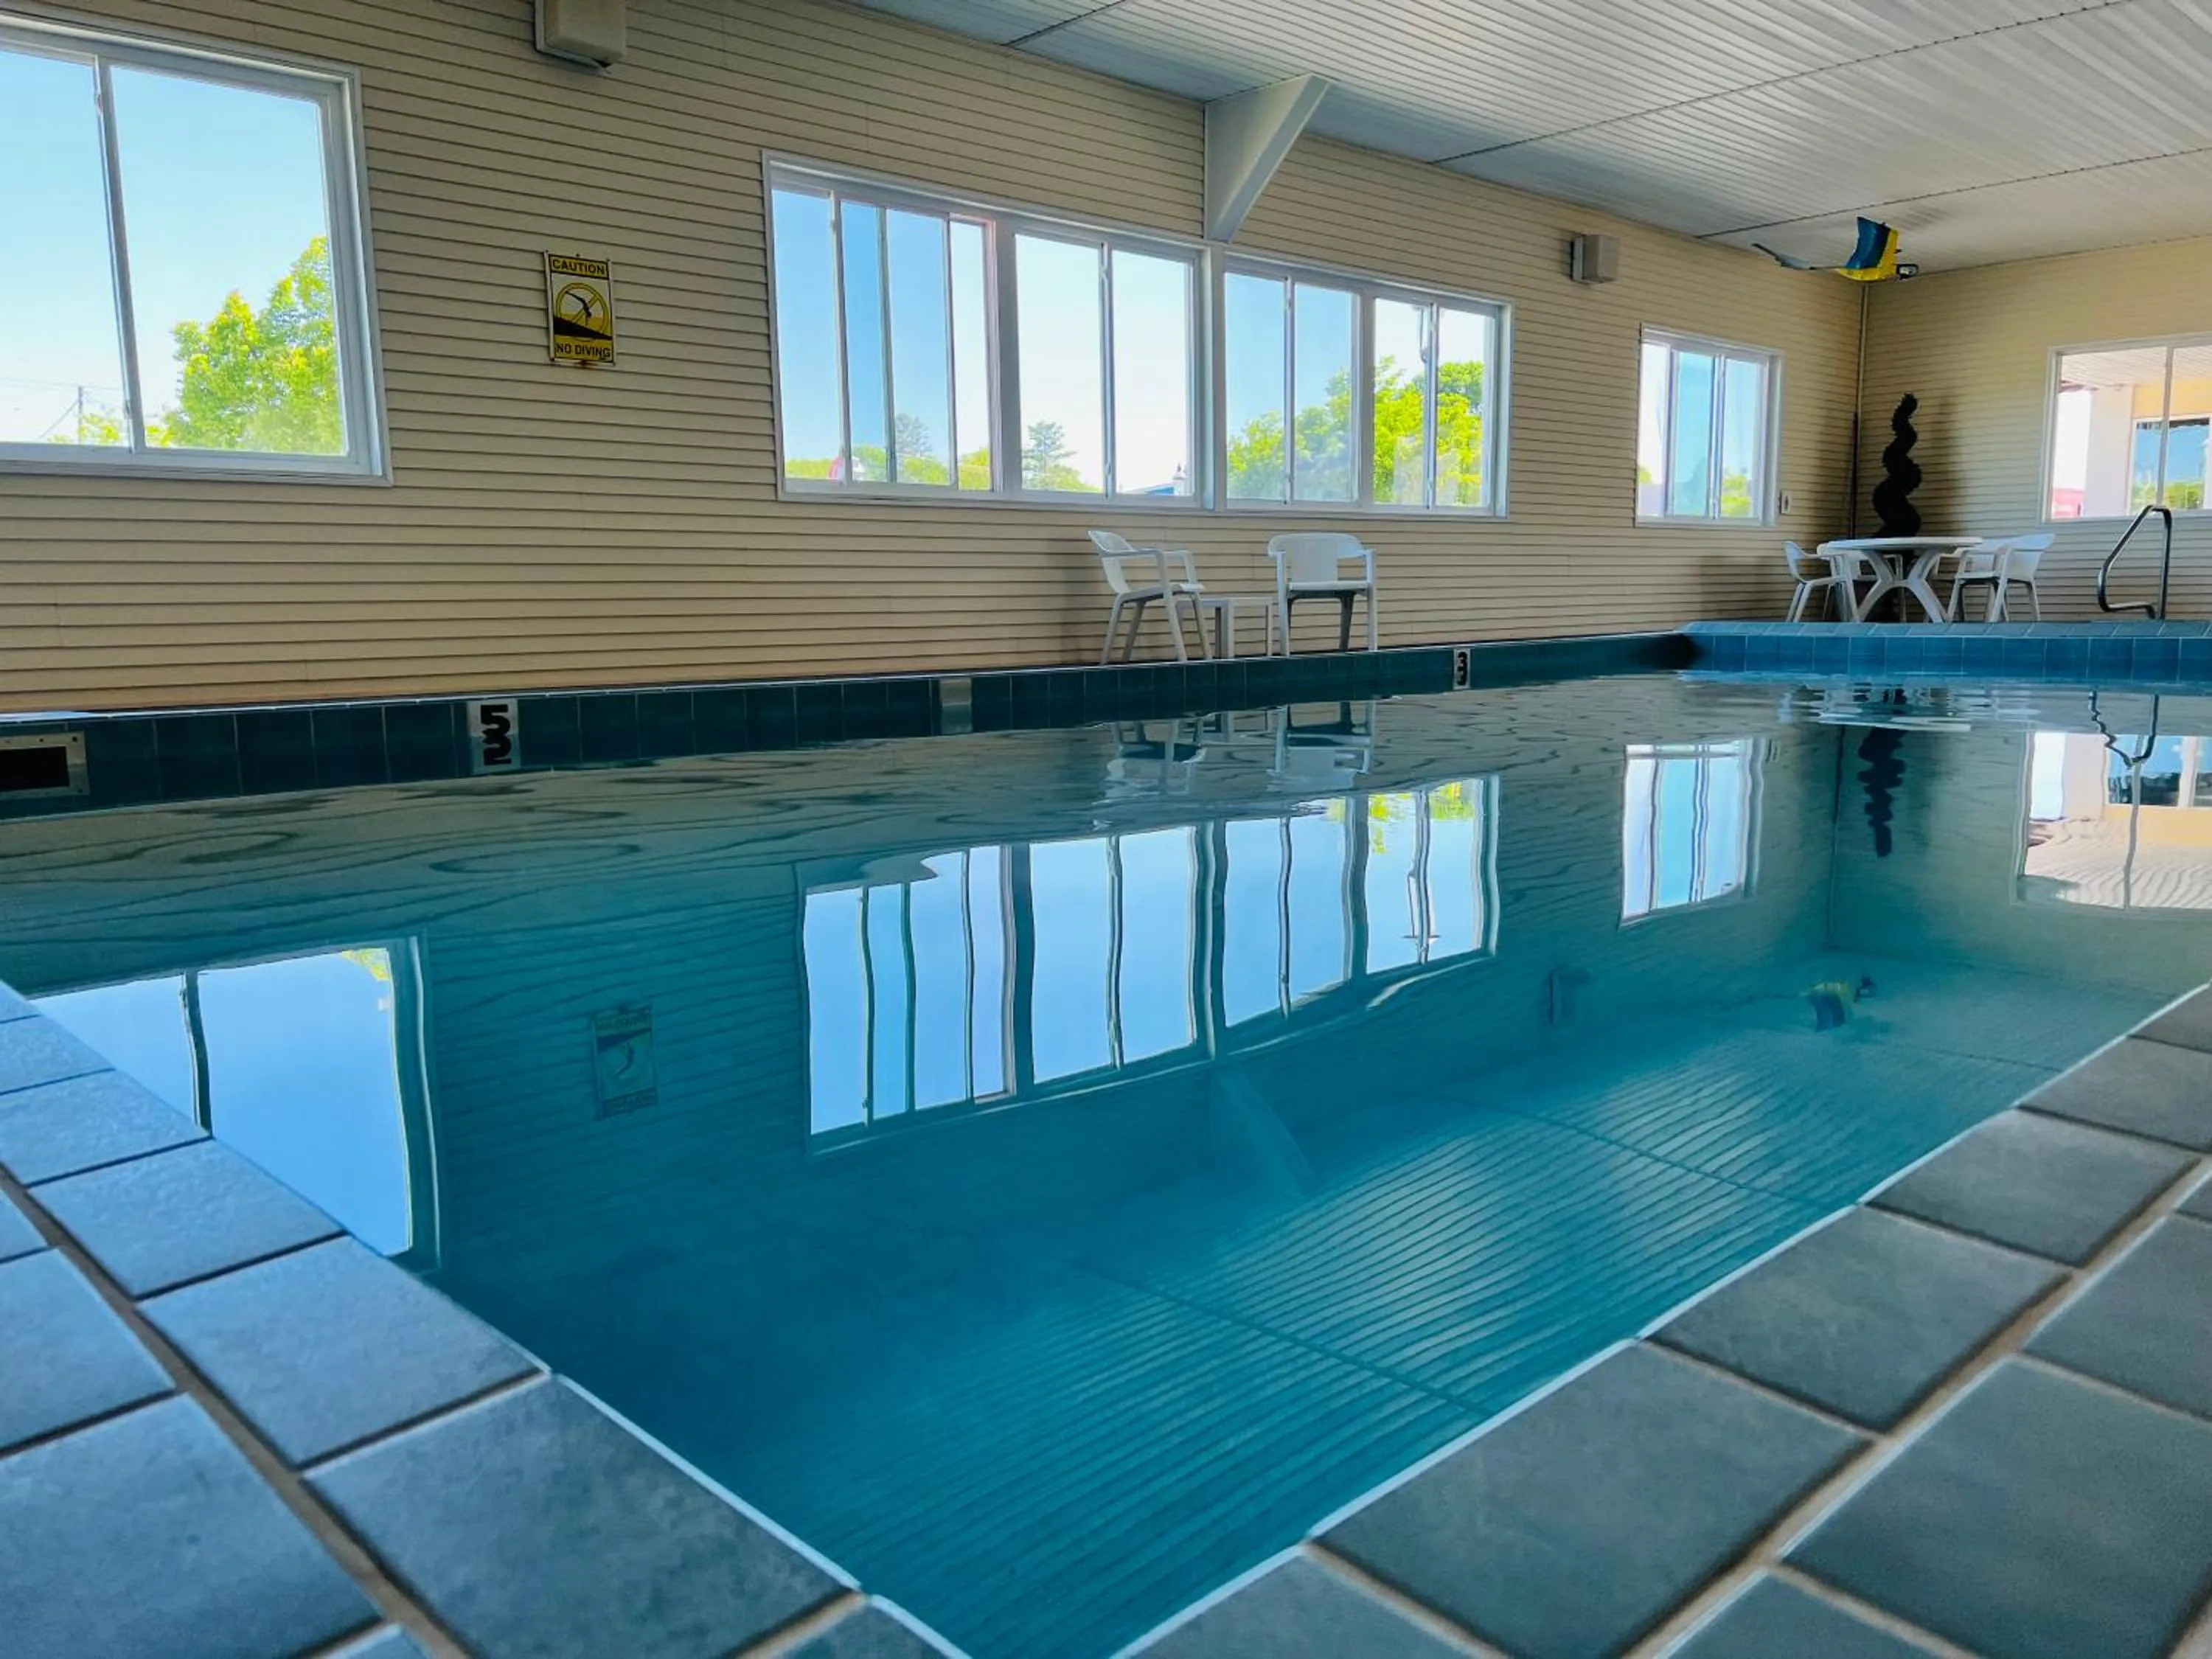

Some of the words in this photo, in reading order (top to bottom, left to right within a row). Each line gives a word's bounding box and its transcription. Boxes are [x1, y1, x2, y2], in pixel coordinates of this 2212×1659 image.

[553, 259, 605, 275] CAUTION
[556, 344, 571, 354] NO
[575, 344, 611, 358] DIVING
